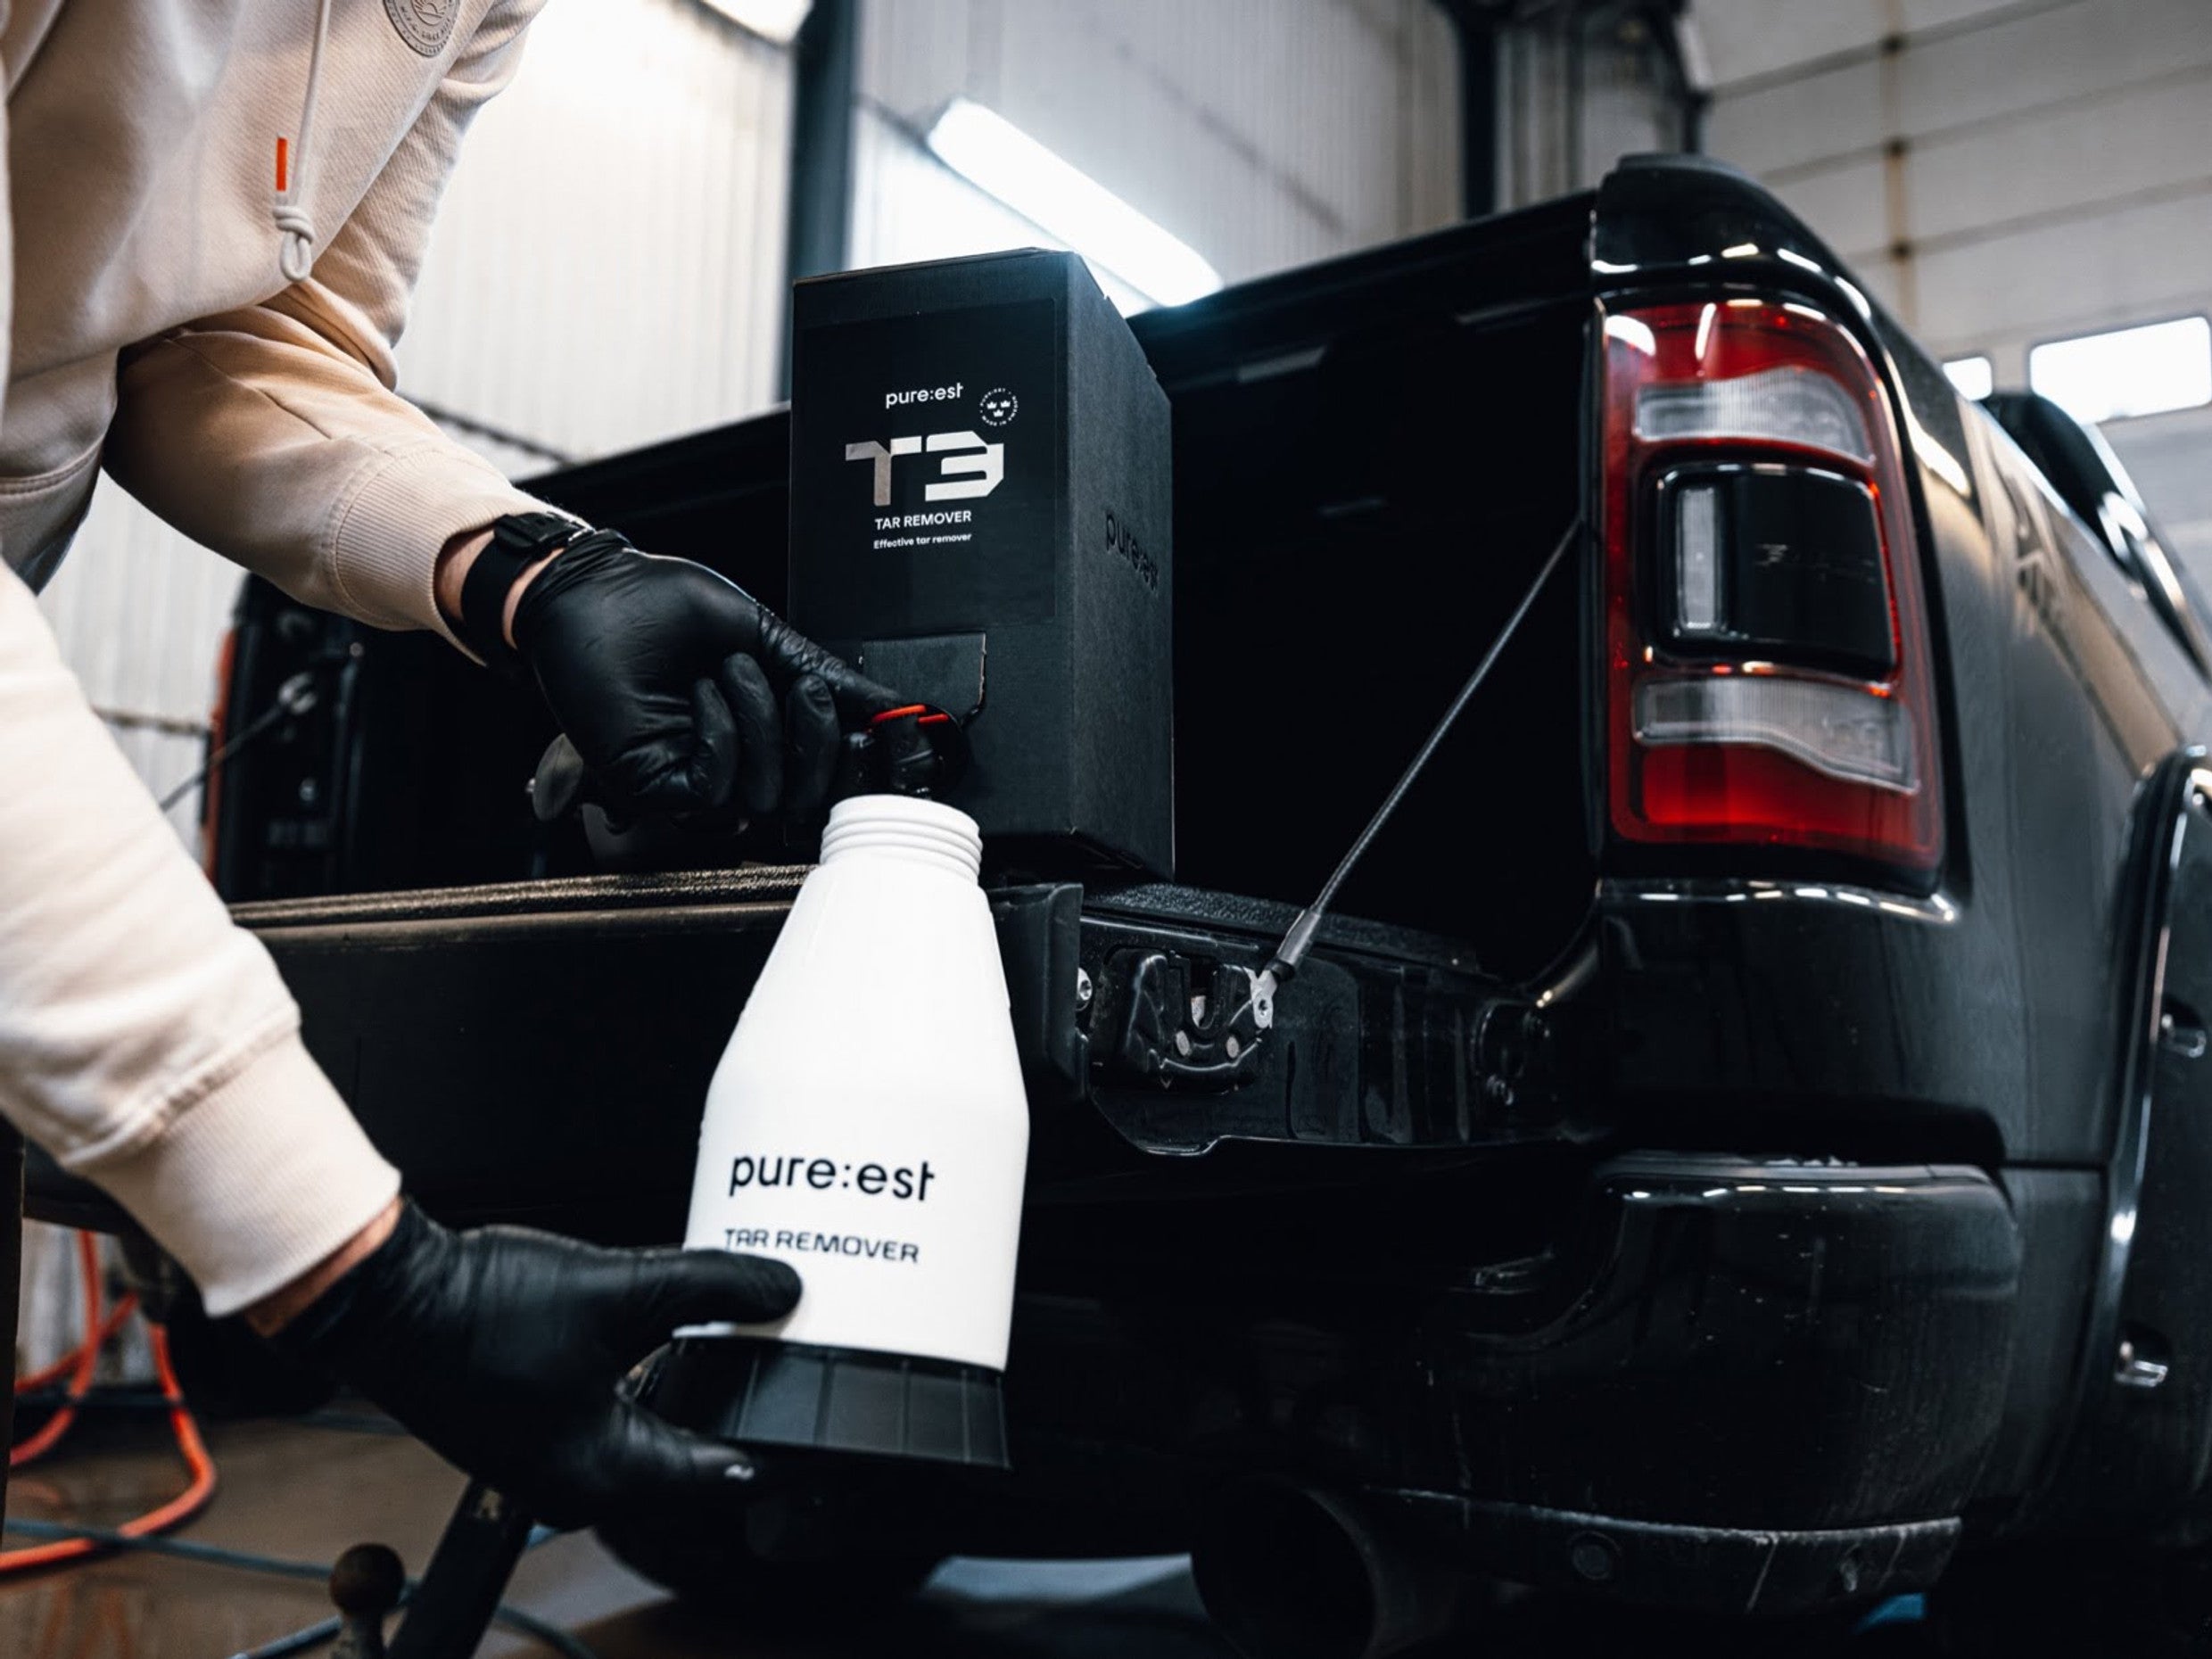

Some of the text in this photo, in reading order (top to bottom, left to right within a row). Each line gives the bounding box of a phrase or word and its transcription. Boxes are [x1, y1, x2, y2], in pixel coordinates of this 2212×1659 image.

[886, 382, 964, 409] pure:est
[846, 430, 1004, 507] T3
[874, 510, 972, 531] TAR REMOVER
[873, 533, 972, 549] Effective tar remover
[729, 1156, 936, 1201] pure:est
[724, 1228, 920, 1263] TAR REMOVER
